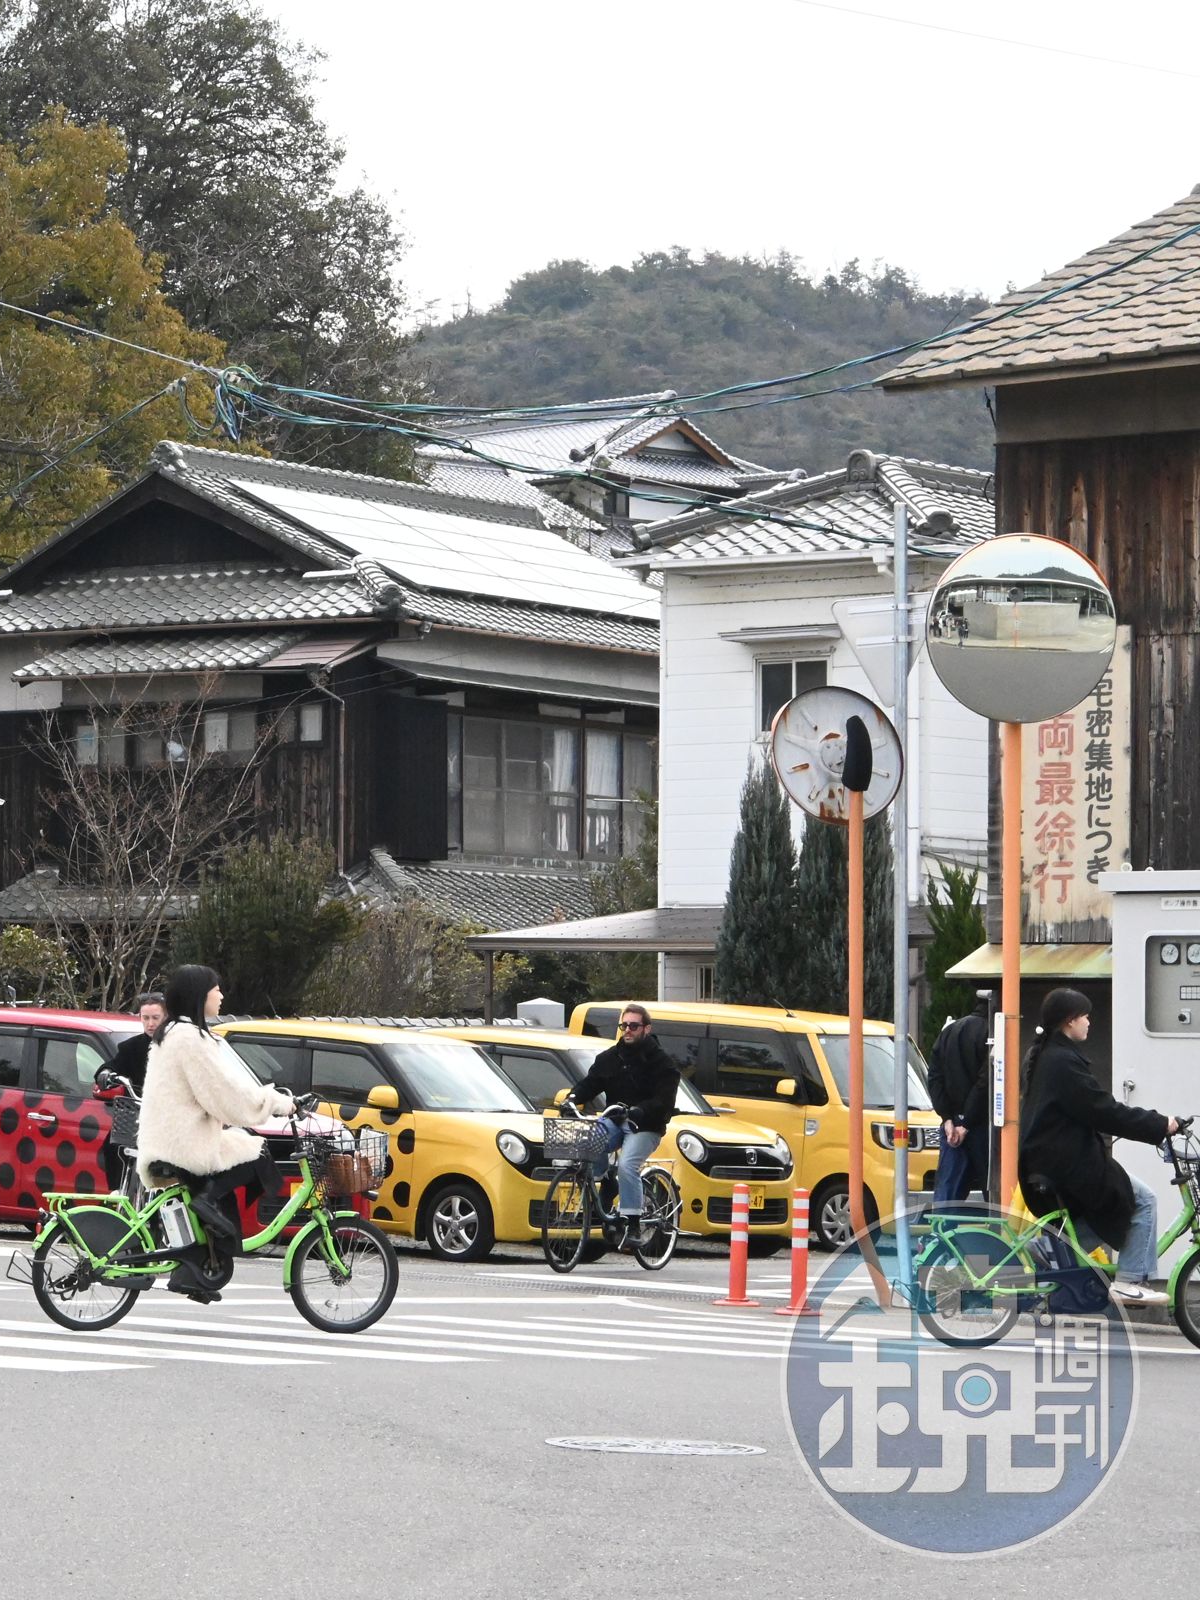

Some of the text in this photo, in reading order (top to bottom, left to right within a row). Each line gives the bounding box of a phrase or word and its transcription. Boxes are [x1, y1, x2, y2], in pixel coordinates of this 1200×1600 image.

[1084, 668, 1113, 884] 宅密集地につき
